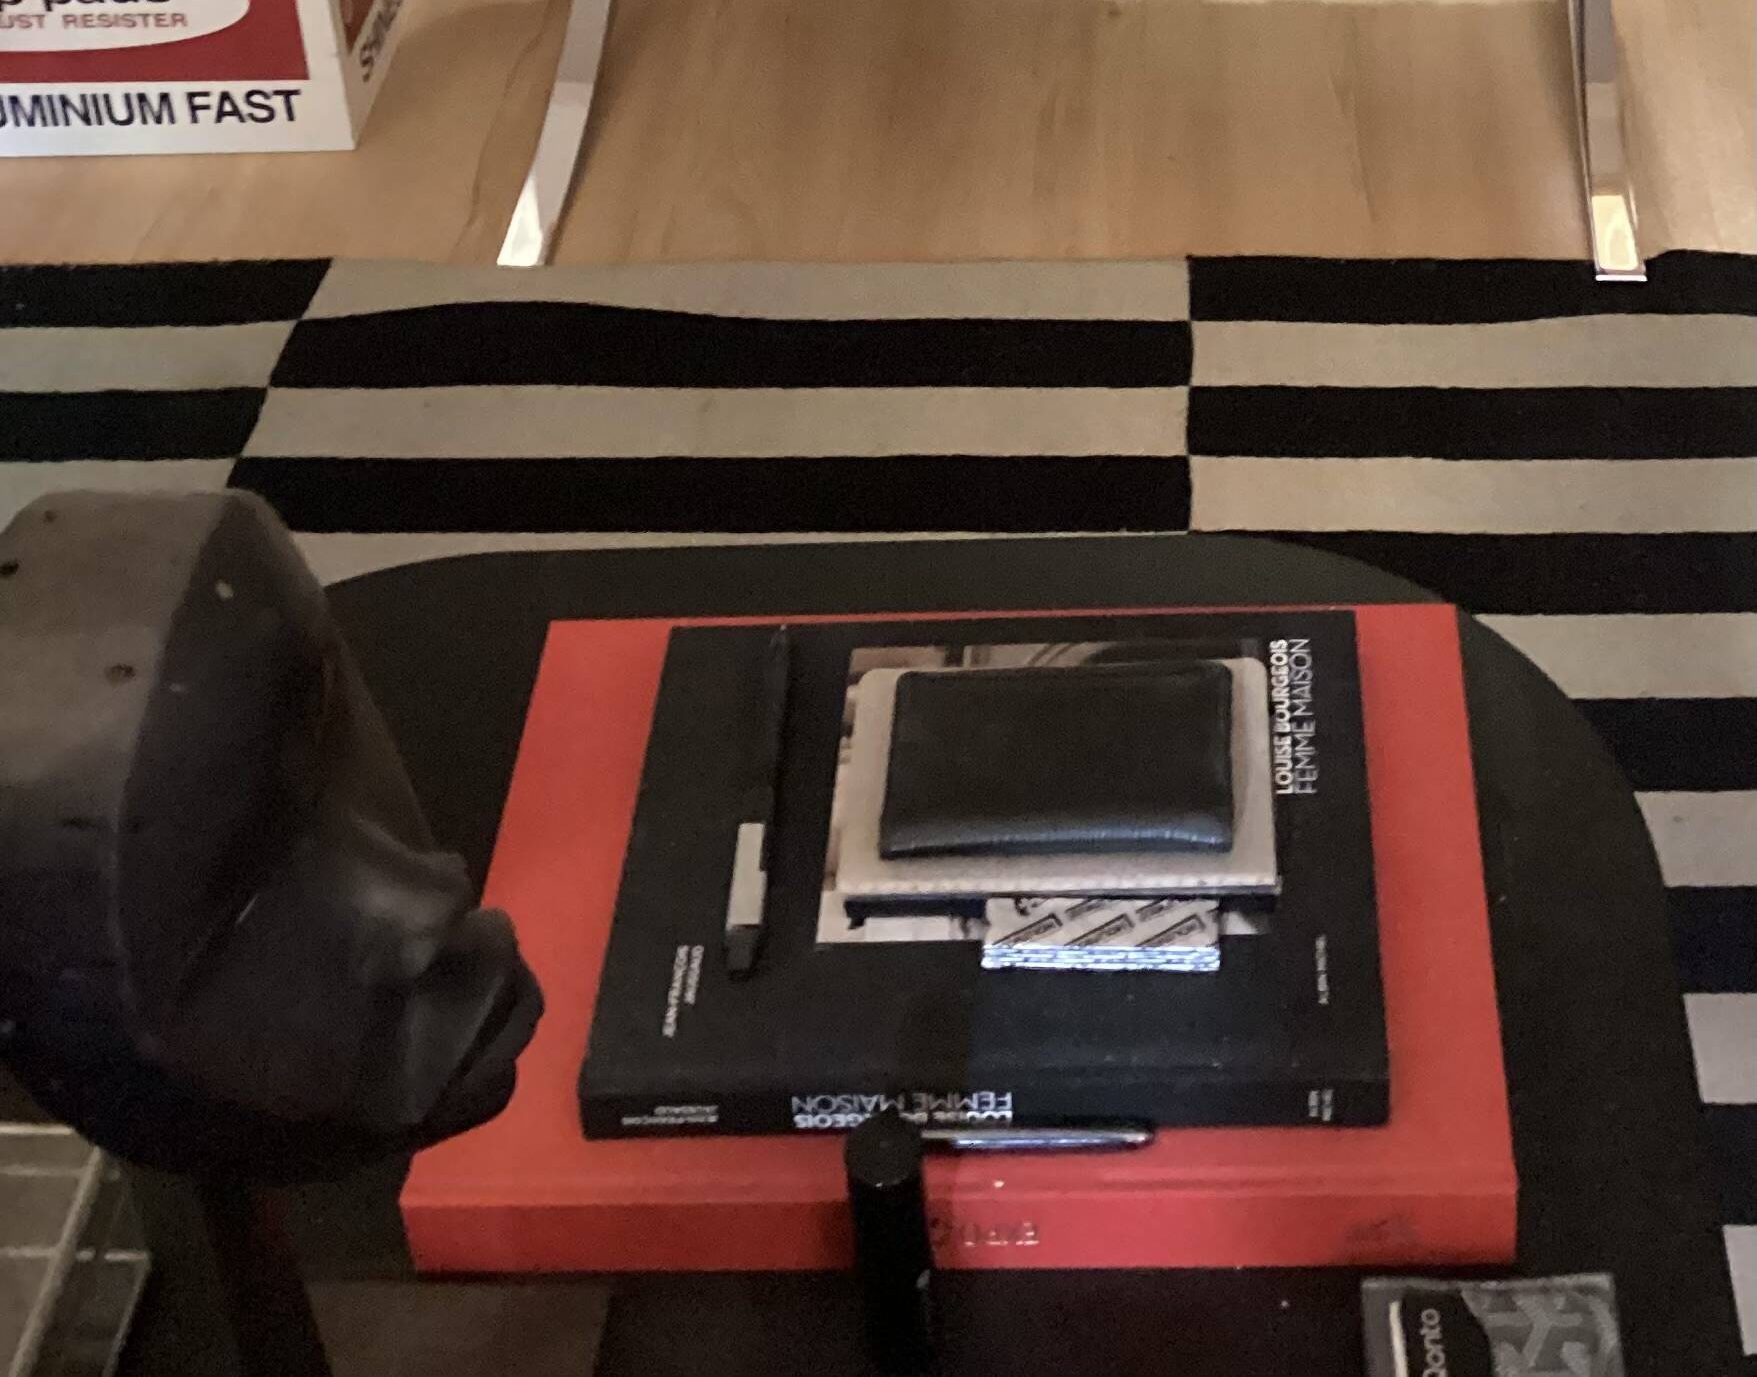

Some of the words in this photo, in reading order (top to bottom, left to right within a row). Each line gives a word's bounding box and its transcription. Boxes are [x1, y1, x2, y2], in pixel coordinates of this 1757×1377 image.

[62, 13, 188, 29] RESISTER
[0, 91, 175, 127] MINIUM
[186, 89, 302, 124] FAST
[1269, 639, 1291, 733] BOURGEOIS
[1288, 638, 1314, 716] MAISON
[1273, 735, 1294, 795] LOUISE
[1294, 719, 1318, 795] FEMME
[791, 1094, 904, 1114] MAISON
[913, 1091, 1012, 1112] FEMME
